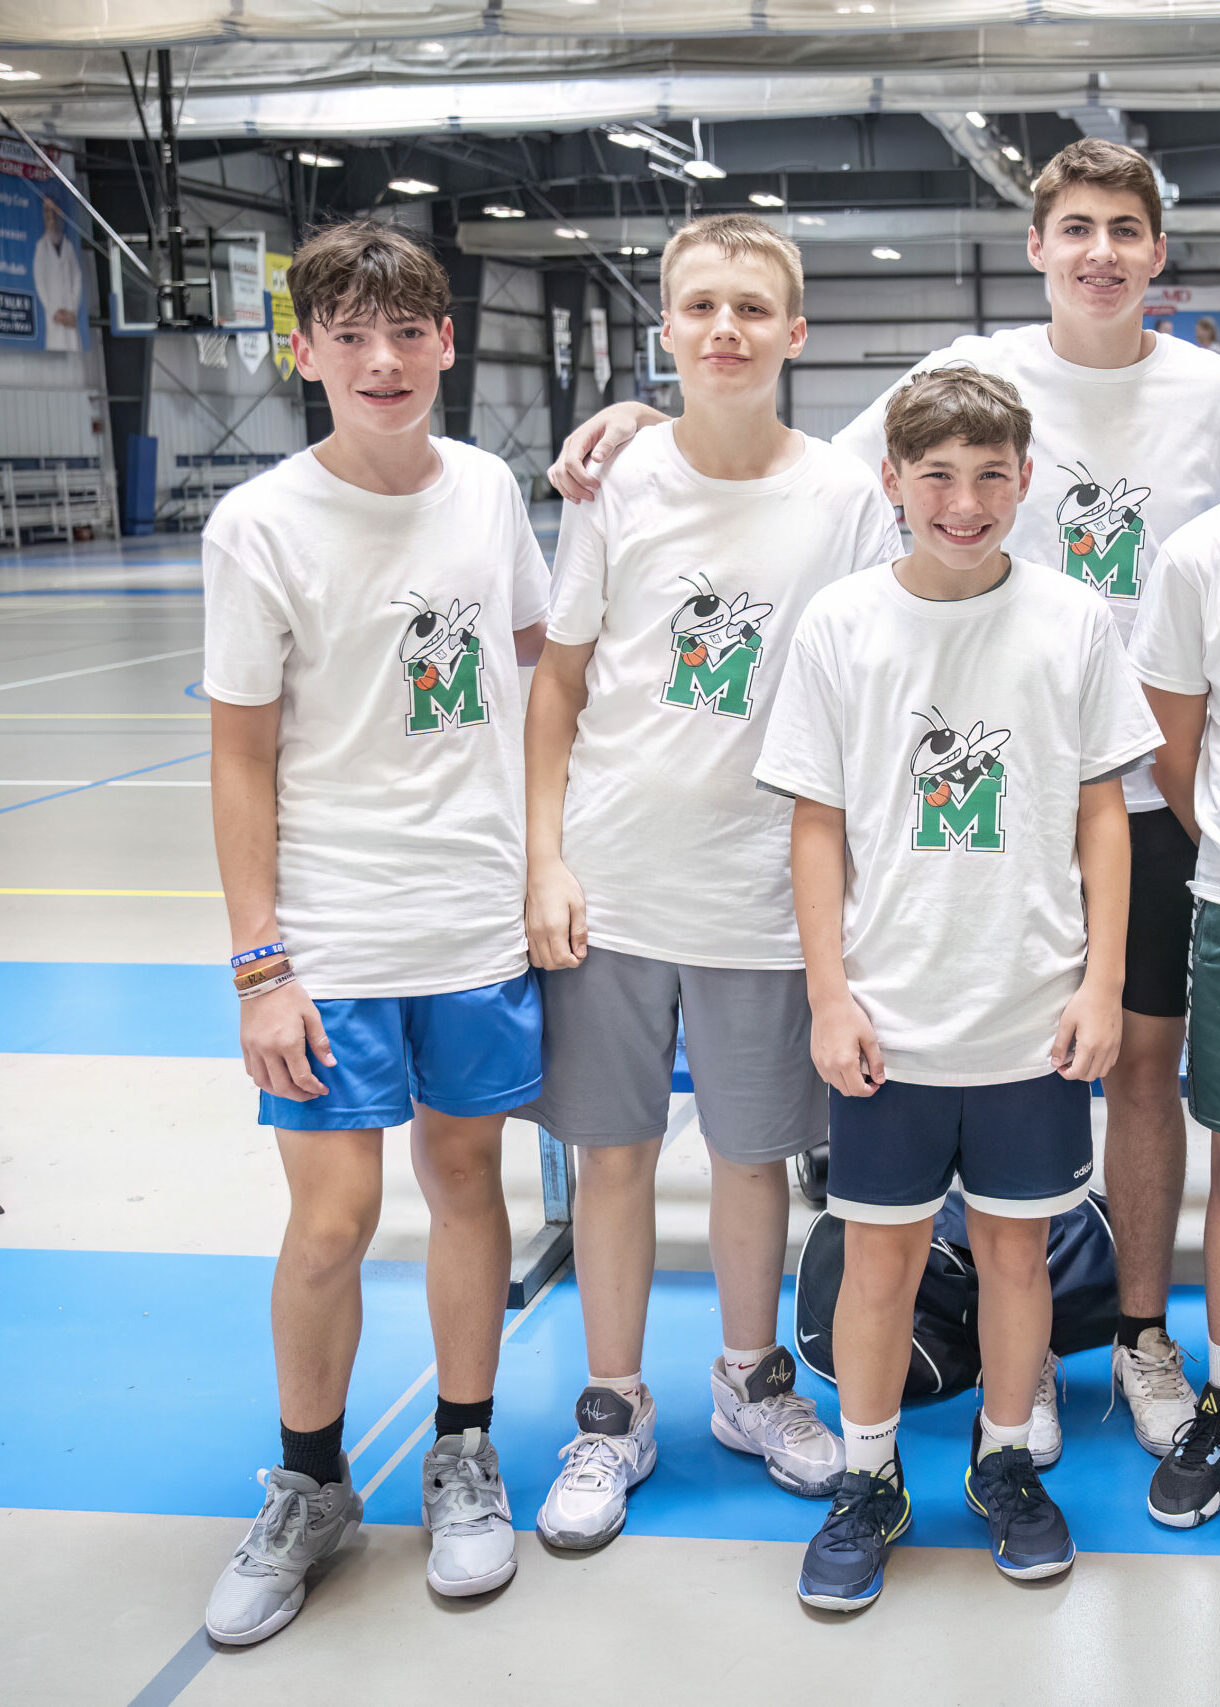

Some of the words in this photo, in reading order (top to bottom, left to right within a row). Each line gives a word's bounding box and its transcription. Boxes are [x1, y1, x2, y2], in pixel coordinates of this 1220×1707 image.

[1059, 525, 1146, 600] M
[404, 648, 490, 736] M
[660, 633, 764, 721] M
[912, 775, 1008, 852] M
